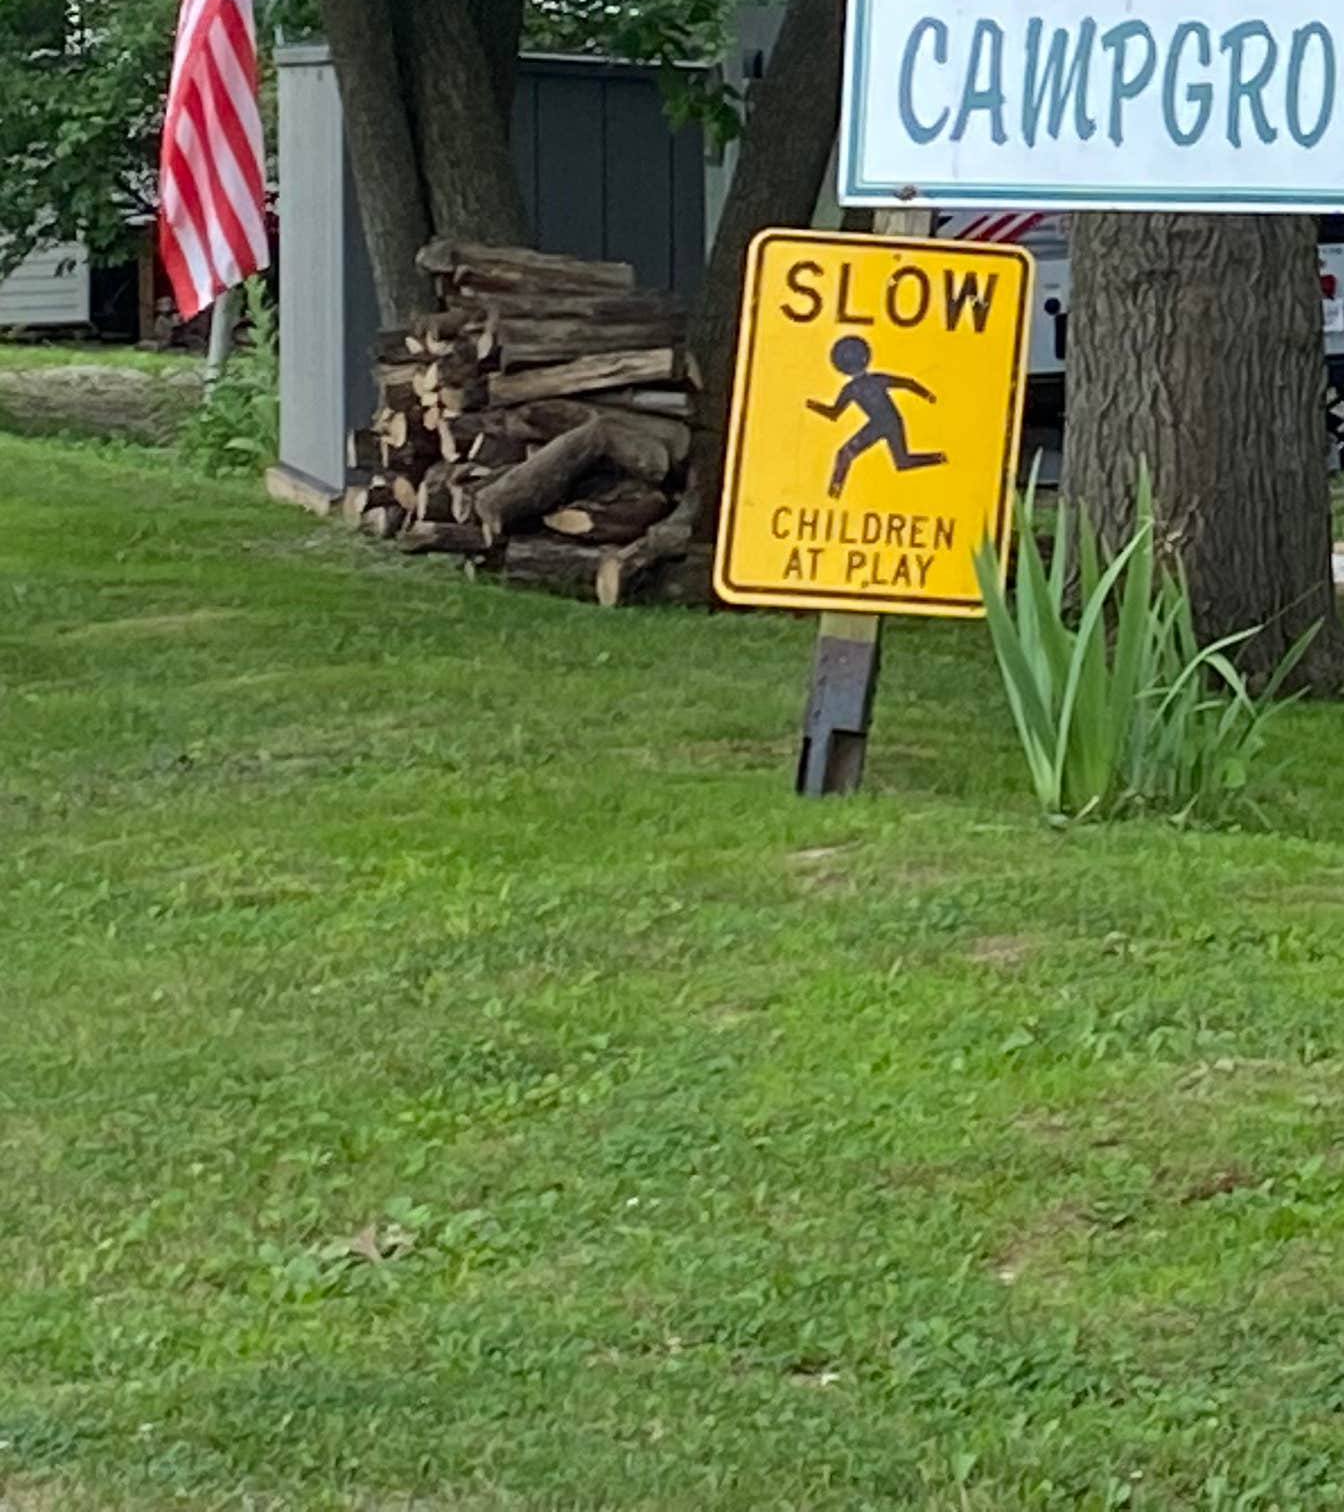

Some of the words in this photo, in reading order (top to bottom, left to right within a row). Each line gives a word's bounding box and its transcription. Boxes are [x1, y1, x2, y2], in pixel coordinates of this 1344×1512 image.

[779, 260, 999, 334] SLOW
[770, 506, 957, 551] CHILDREN
[782, 547, 827, 582] AT
[845, 550, 936, 588] PLAY
